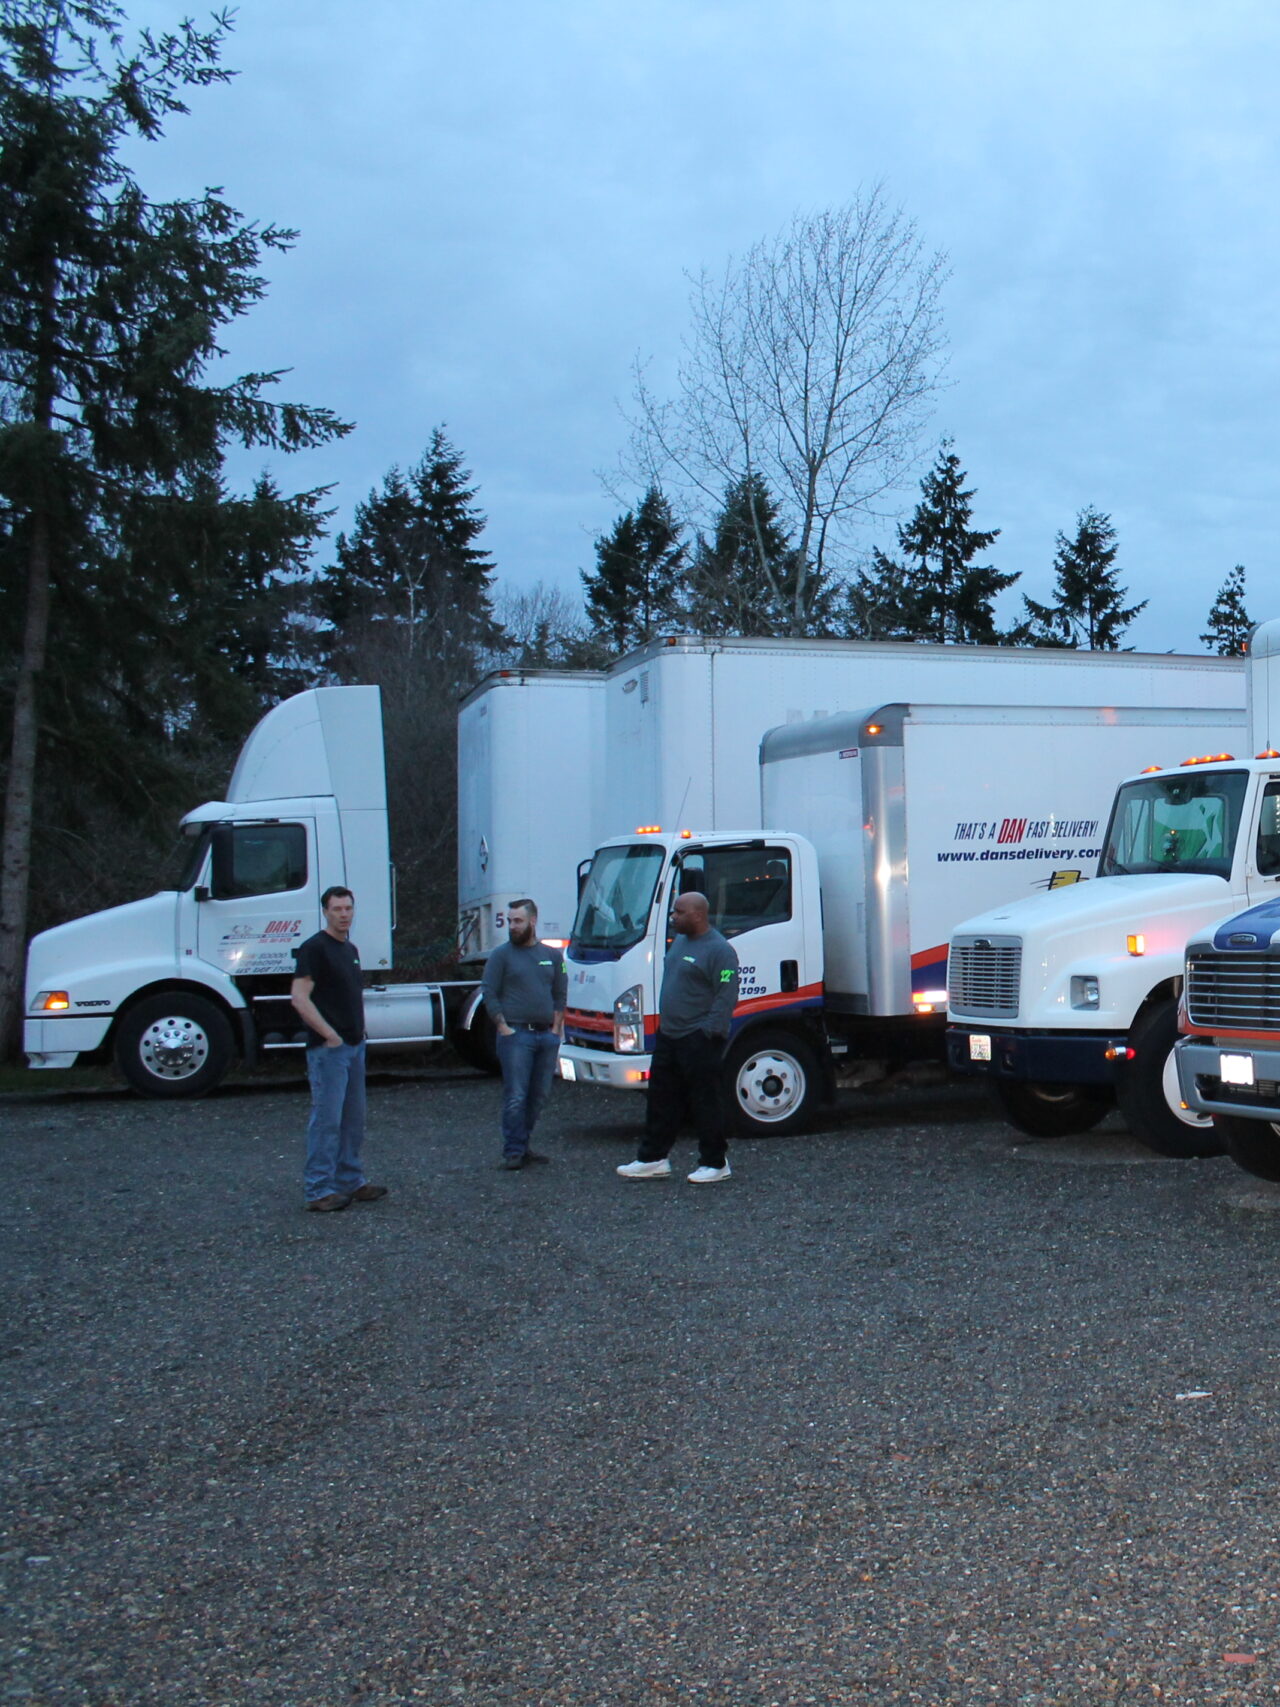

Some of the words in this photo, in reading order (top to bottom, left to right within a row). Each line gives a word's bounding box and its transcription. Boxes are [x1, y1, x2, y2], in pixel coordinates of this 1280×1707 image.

[988, 822, 996, 840] A
[997, 818, 1027, 844] DAN
[1026, 821, 1050, 839] FAST
